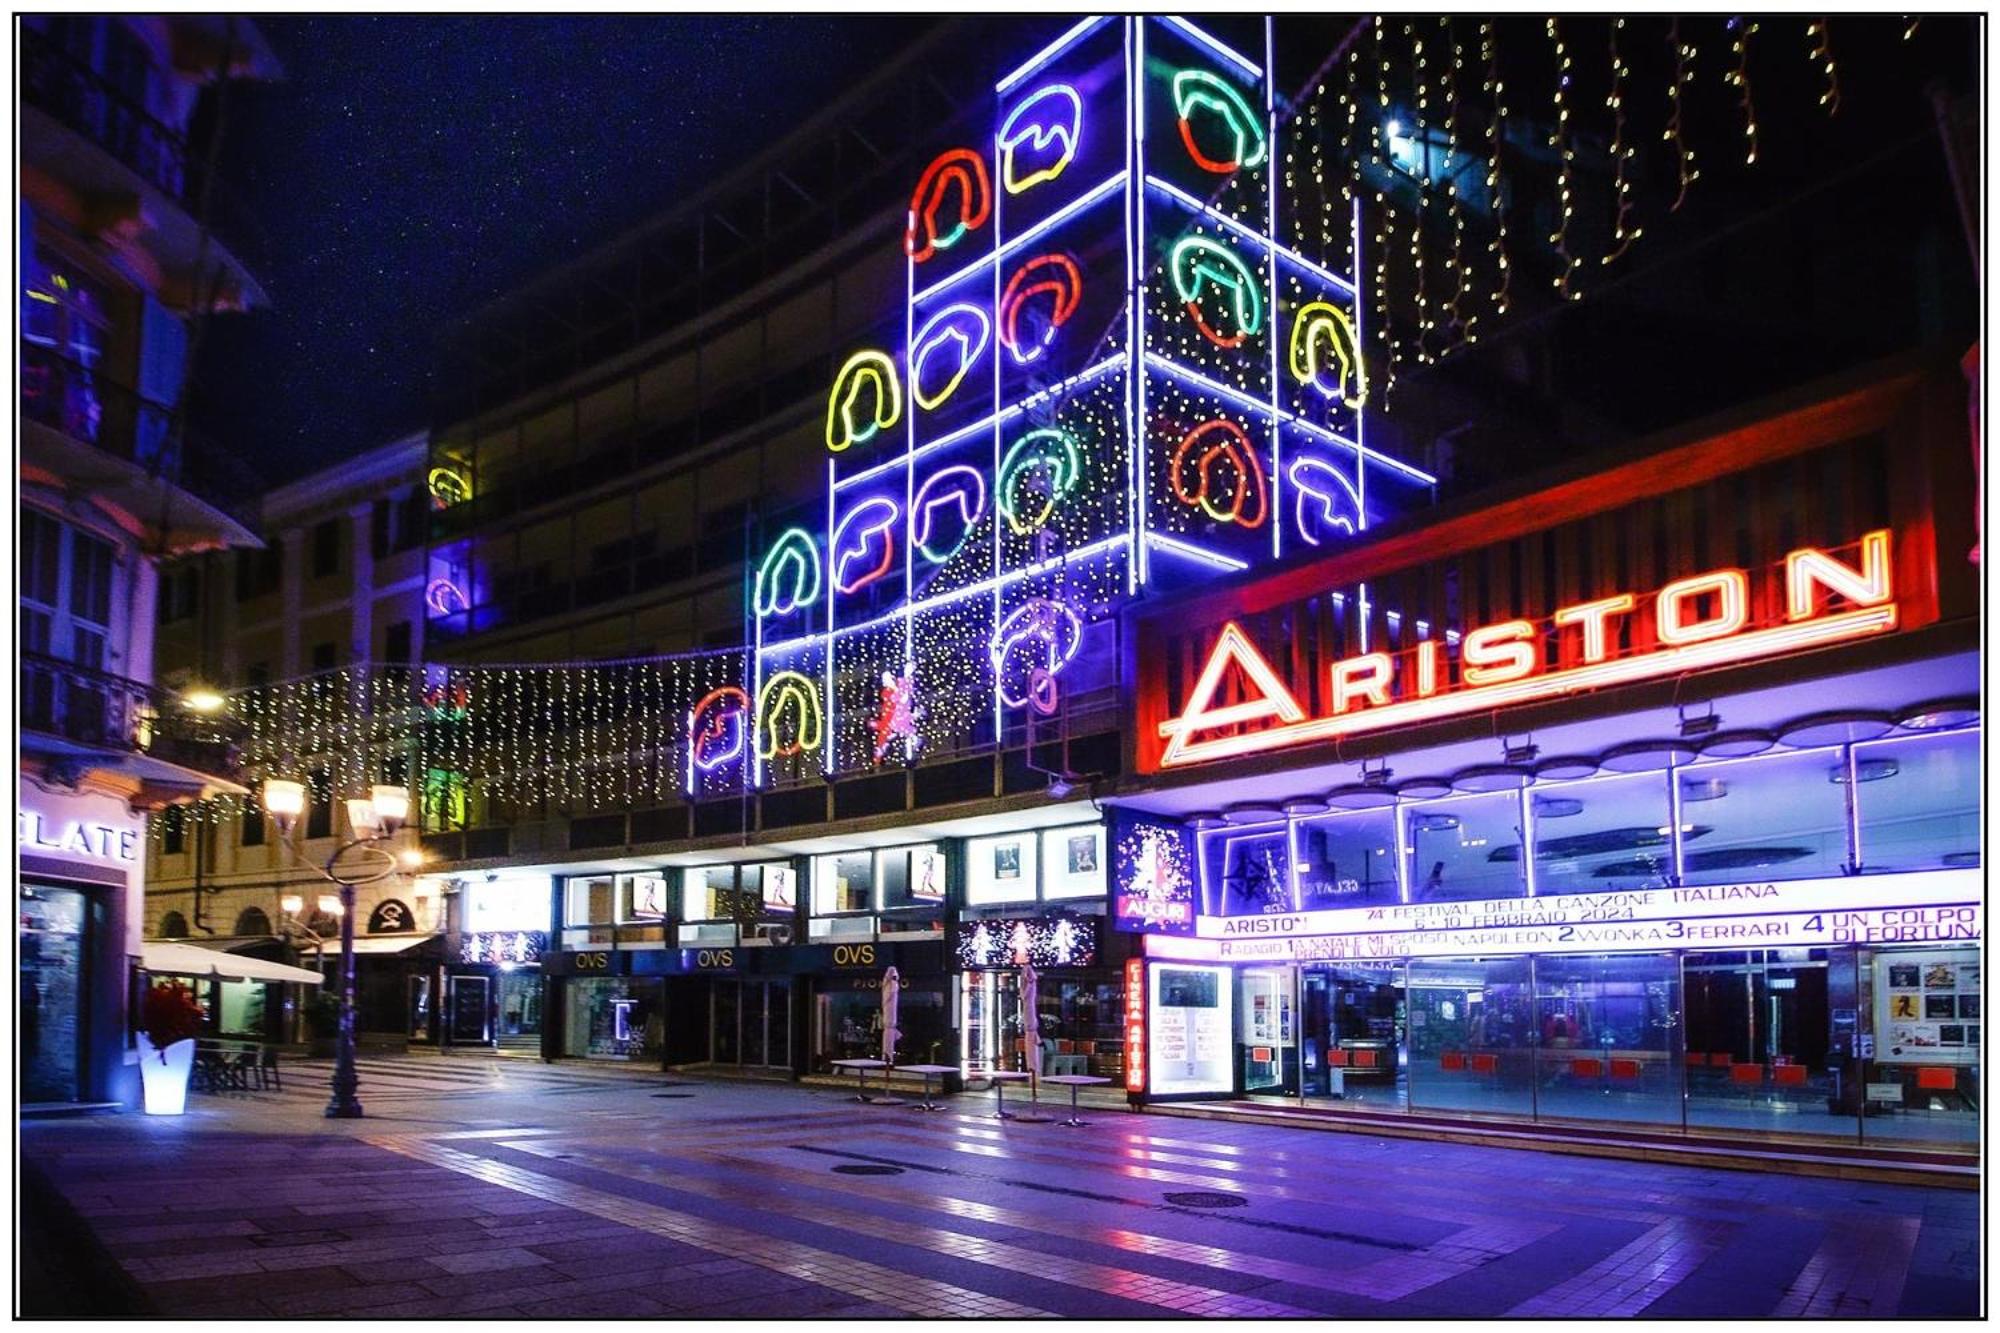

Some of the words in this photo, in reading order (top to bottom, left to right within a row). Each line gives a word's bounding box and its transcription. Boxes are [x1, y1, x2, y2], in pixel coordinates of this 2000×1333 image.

[1159, 529, 1891, 767] ARISTON
[1393, 904, 1473, 919] FESTIVAL
[1484, 898, 1546, 914] DELLA
[1556, 892, 1655, 908] CANZONE
[1673, 884, 1779, 903] ITALIANA
[1444, 917, 1460, 929] 10
[1473, 911, 1566, 928] FEBBRAIO
[1580, 908, 1634, 922] 2024
[1803, 915, 1825, 933] 4
[1832, 913, 1868, 927] UN
[1882, 908, 1975, 925] COLPO
[1576, 928, 1662, 941] WONKA
[1666, 921, 1684, 939] 3
[1687, 922, 1789, 939] FERRARI
[1832, 928, 1857, 942] DI
[1310, 936, 1361, 949] NATALE
[1368, 935, 1384, 946] MI
[1390, 932, 1448, 945] SPOSO
[1454, 931, 1552, 946] NAPOLEON
[576, 952, 608, 968] OVS
[697, 950, 733, 966] OVS
[834, 944, 875, 964] OVS
[1295, 947, 1345, 960] PRENDI
[1368, 945, 1410, 957] VOLO
[1130, 963, 1142, 1019] CINEMA
